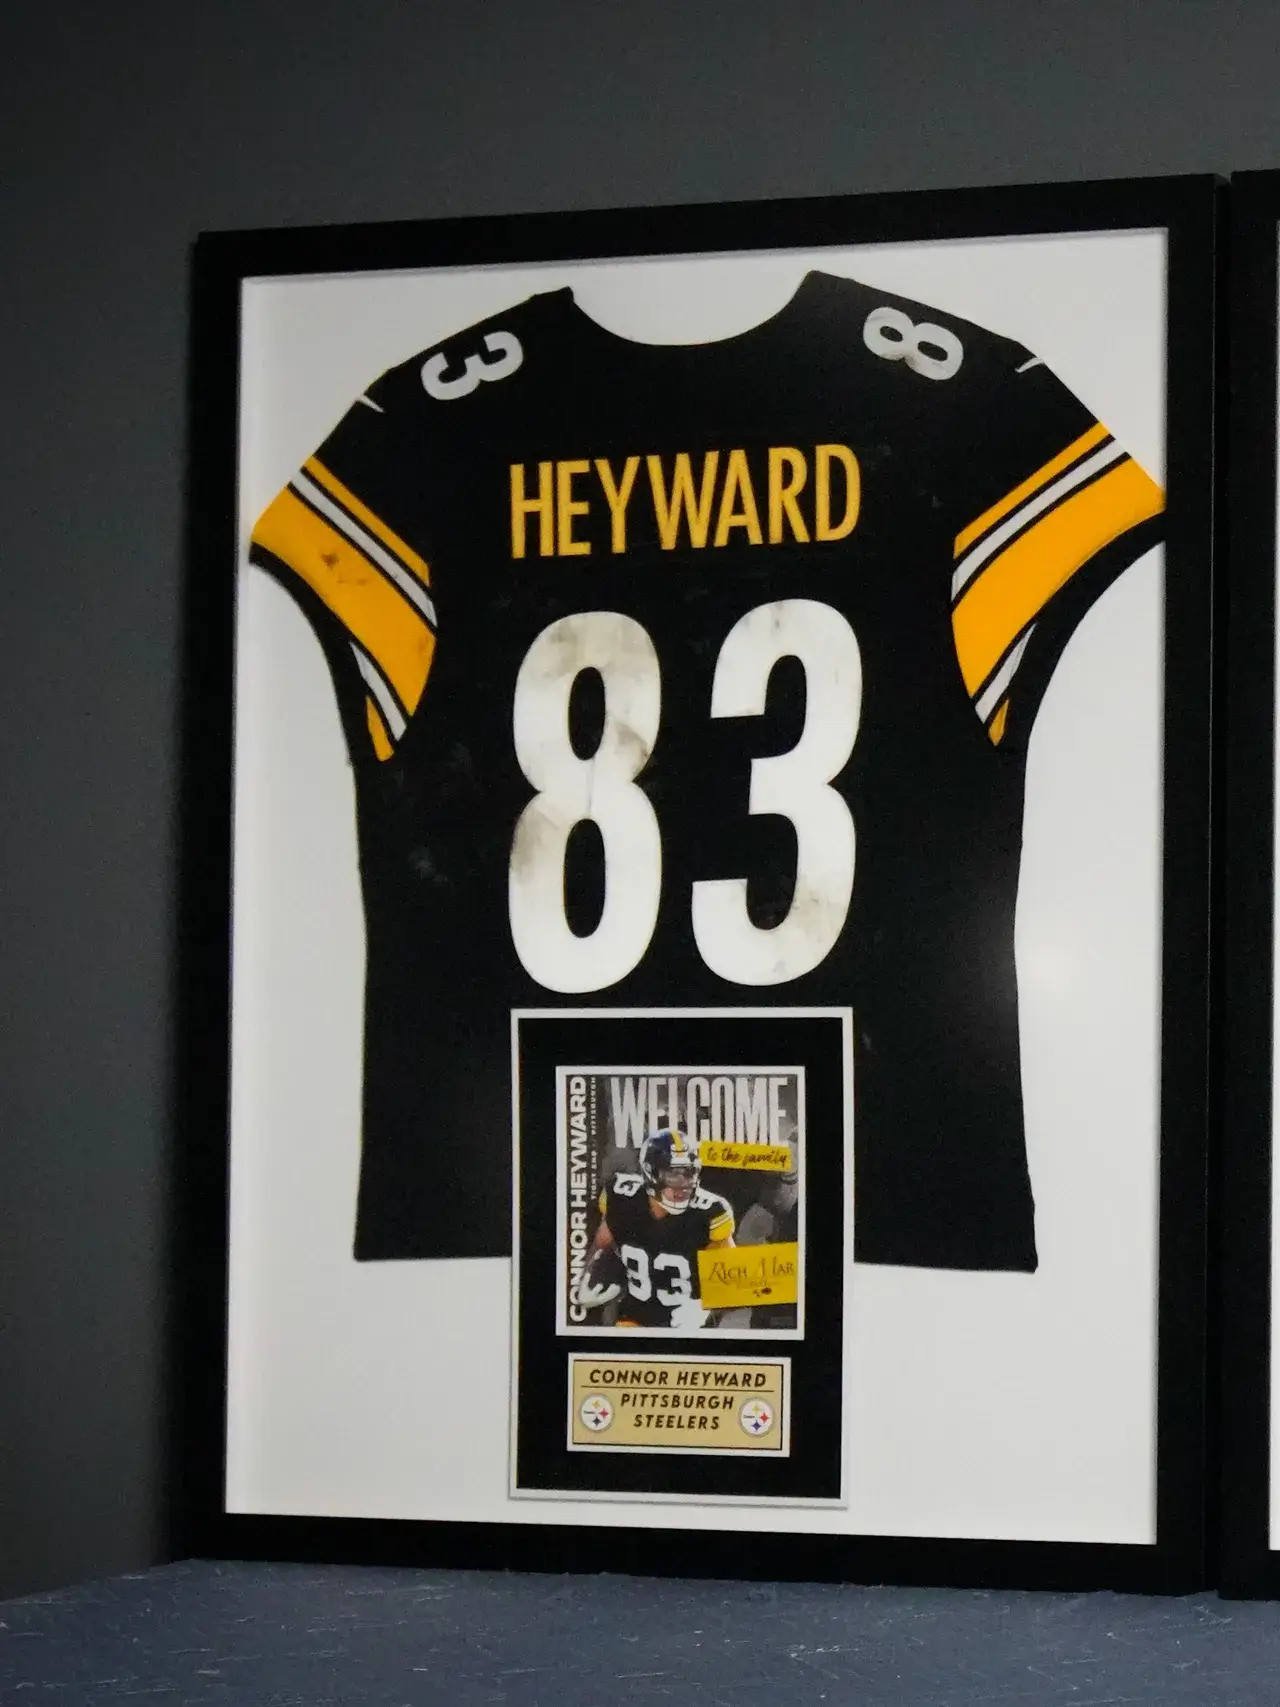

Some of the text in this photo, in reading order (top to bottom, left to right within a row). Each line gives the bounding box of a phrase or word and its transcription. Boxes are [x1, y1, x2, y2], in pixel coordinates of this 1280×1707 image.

[420, 330, 523, 401] 3
[863, 306, 964, 381] 8
[509, 444, 862, 560] HEYWARD
[508, 598, 863, 994] 83
[610, 1076, 789, 1149] WELCOME
[722, 1147, 740, 1163] the
[742, 1148, 787, 1168] family
[570, 1076, 588, 1322] CONNOR HEYWARD
[589, 1369, 767, 1388] CONNOR HEYWARD
[621, 1393, 734, 1410] PITTSBURGH
[633, 1414, 720, 1430] STEELERS
